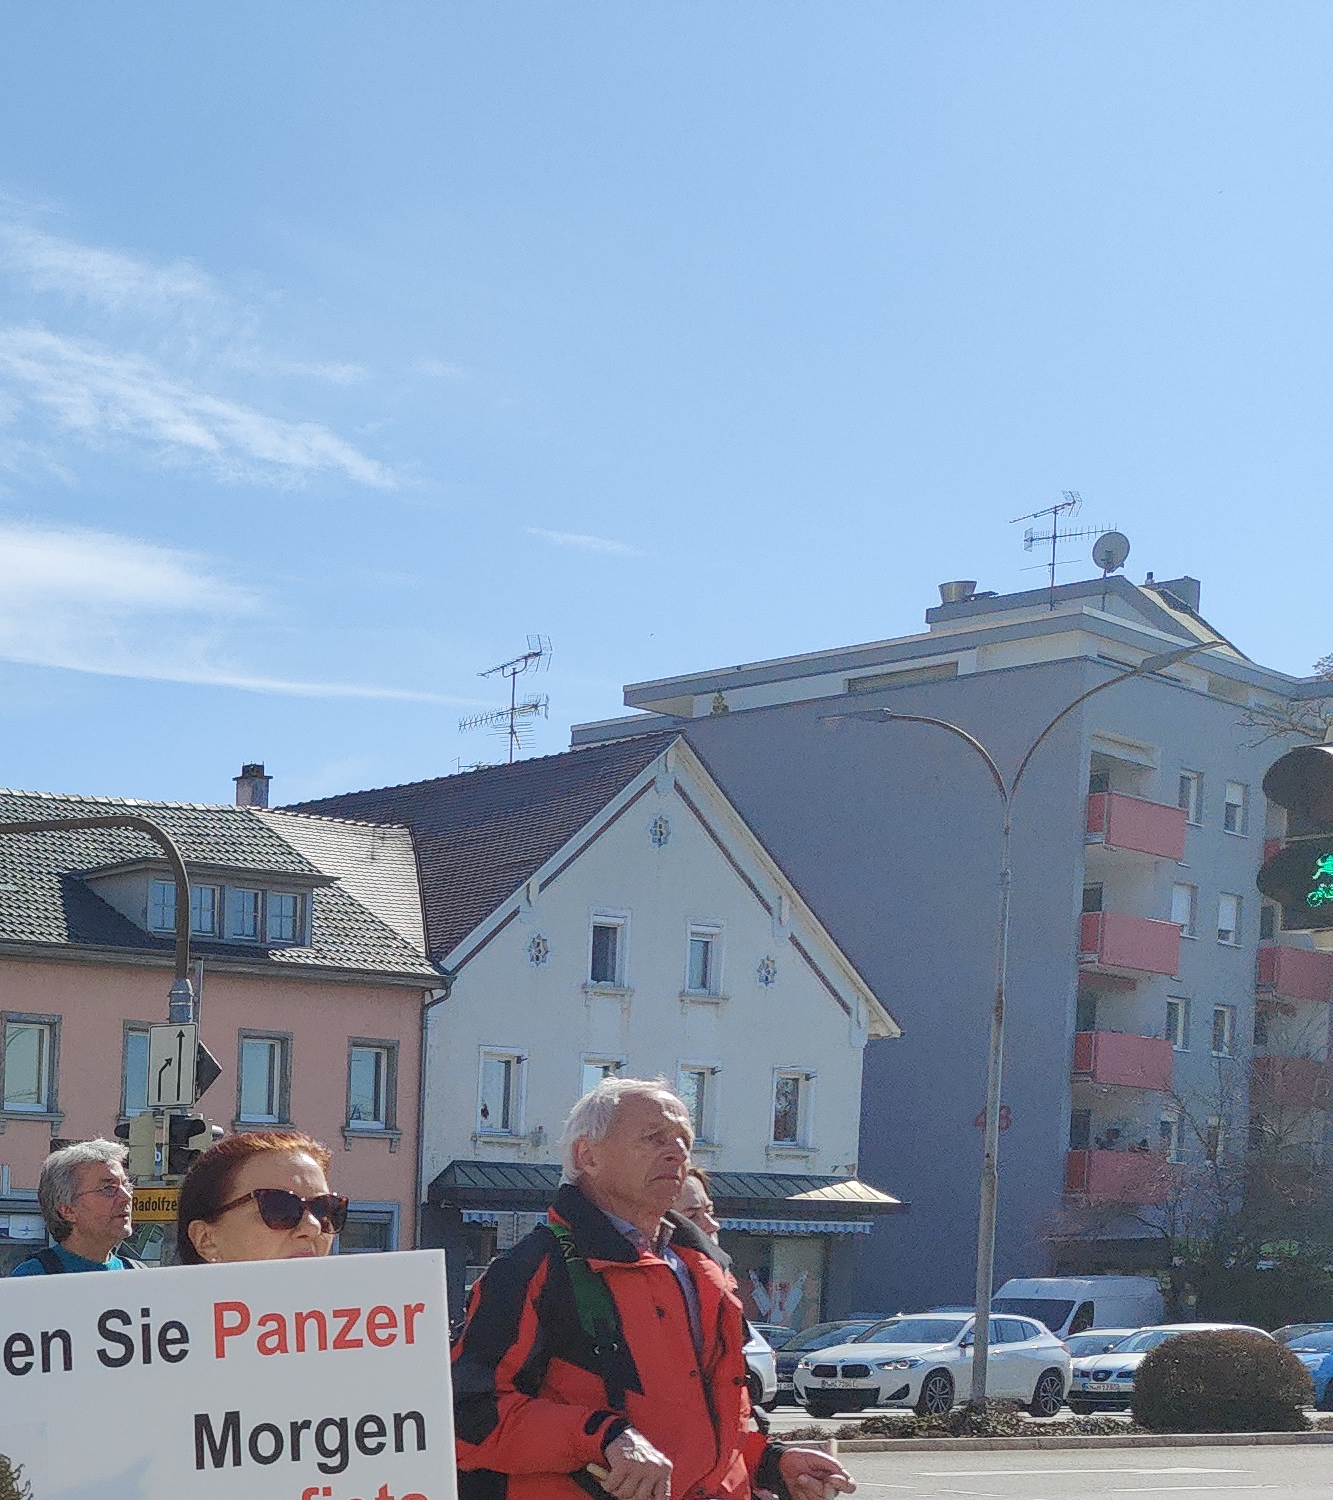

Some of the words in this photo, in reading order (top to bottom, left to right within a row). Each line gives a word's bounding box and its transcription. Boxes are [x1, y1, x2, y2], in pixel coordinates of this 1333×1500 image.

[132, 1196, 178, 1212] Radolfze
[95, 1309, 190, 1369] Sie
[212, 1300, 426, 1359] Panzer
[193, 1410, 427, 1475] Morgen
